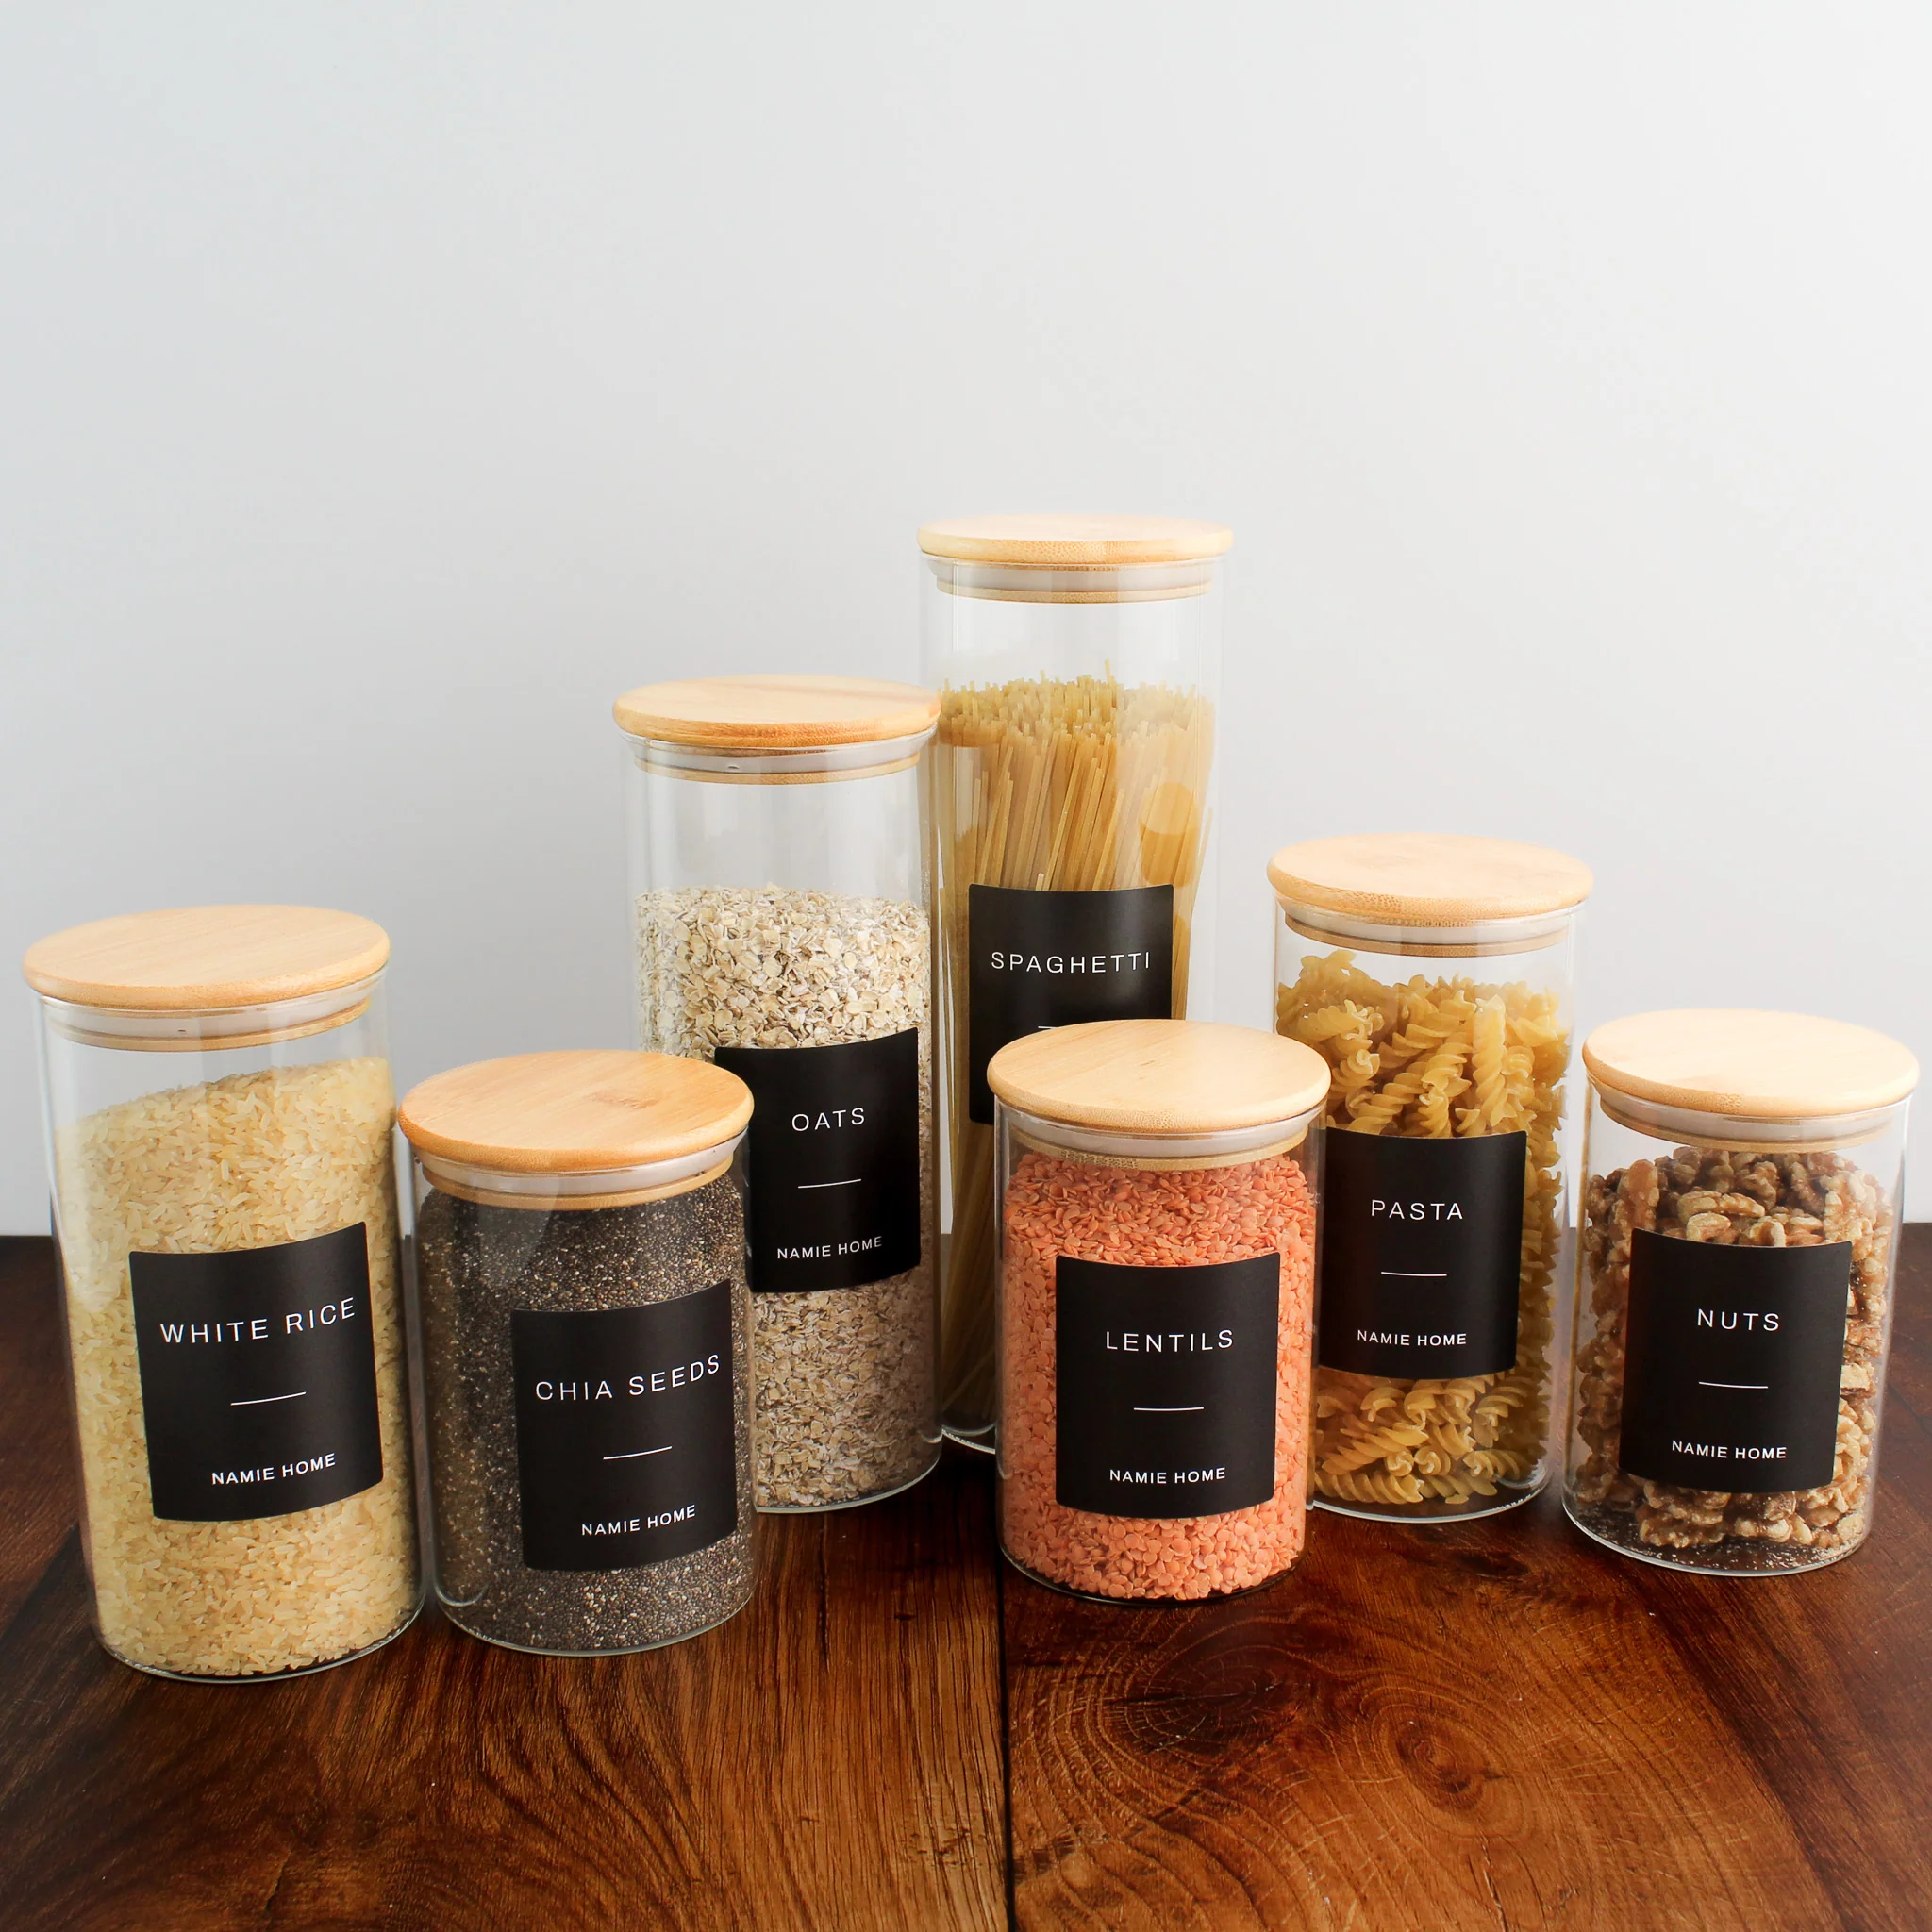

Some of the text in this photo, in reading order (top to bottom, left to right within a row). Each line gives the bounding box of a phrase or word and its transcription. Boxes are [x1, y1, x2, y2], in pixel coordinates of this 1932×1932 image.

[991, 952, 1149, 973] SPAGHETTI
[791, 1108, 865, 1132] OATS
[1371, 1200, 1463, 1221] PASTA
[777, 1236, 882, 1259] NAMIE HOME
[159, 1296, 356, 1343] WHITE RICE
[1697, 1308, 1779, 1332] NUTS
[1106, 1329, 1233, 1353] LENTILS
[1357, 1329, 1467, 1346] NAMIE HOME
[535, 1354, 720, 1402] CHIA SEEDS
[1672, 1440, 1788, 1460] NAMIE HOME
[211, 1452, 336, 1485] NAMIE HOME
[1109, 1466, 1226, 1485] NAMIE HOME
[581, 1504, 696, 1536] NAMIE HOME
